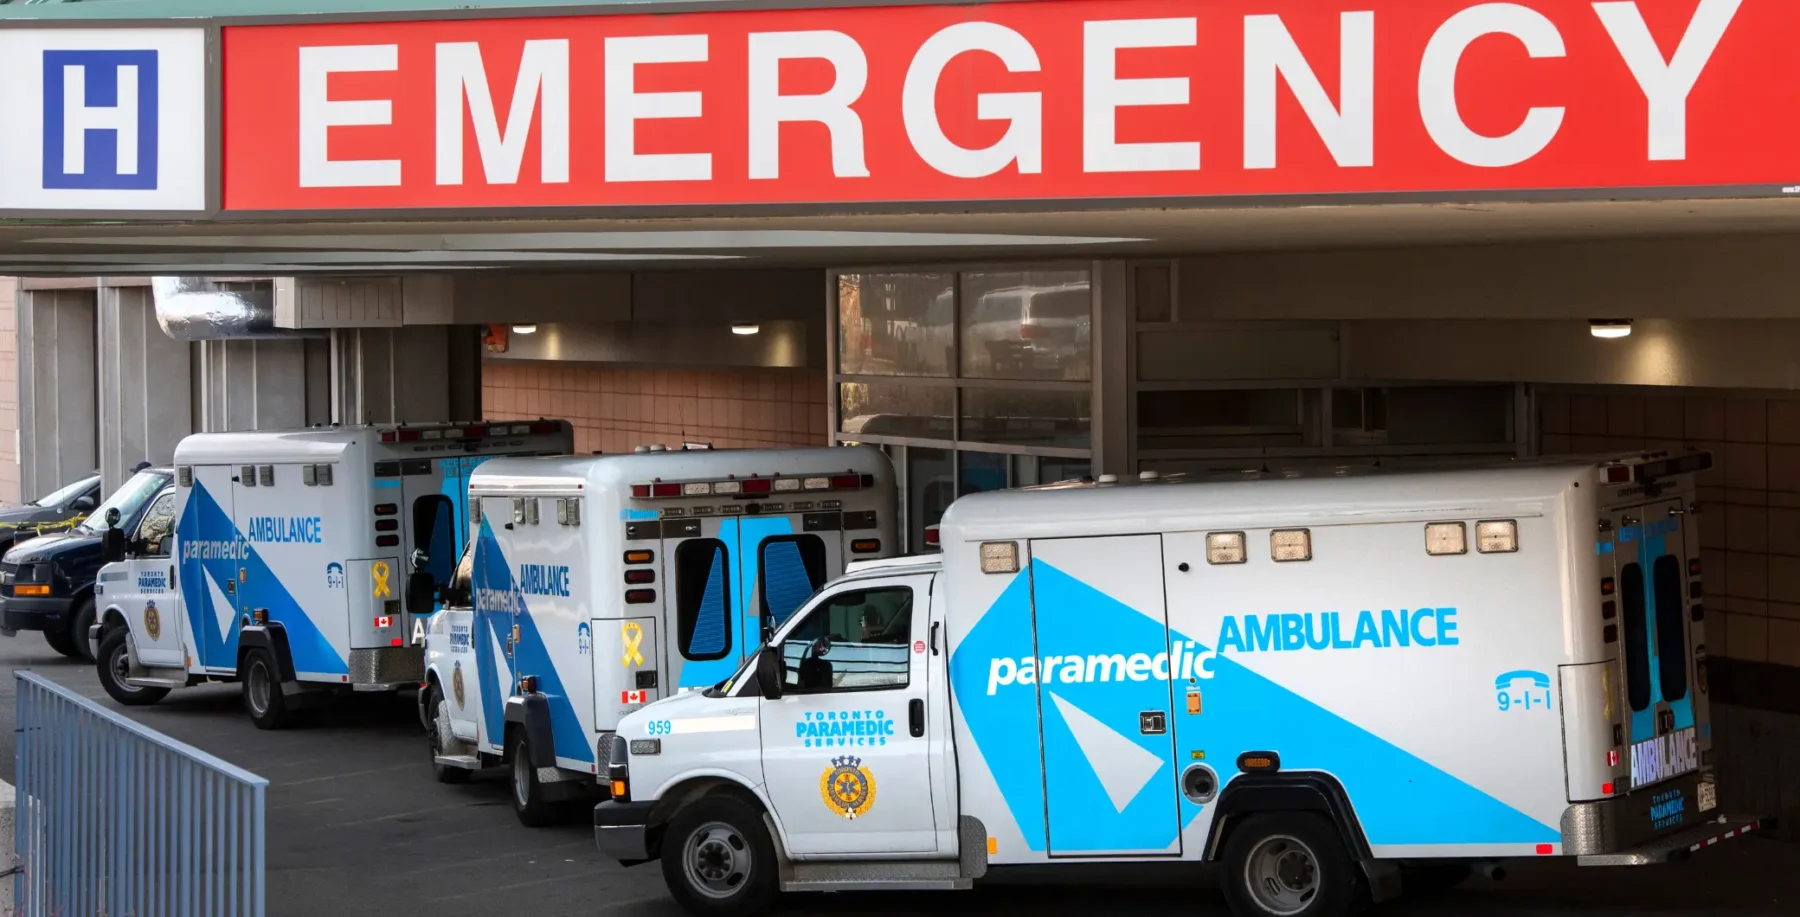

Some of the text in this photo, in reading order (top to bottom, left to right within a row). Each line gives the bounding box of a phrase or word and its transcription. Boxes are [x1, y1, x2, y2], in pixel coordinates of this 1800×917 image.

[299, 0, 1743, 188] EMERGENCY
[63, 65, 138, 175] H
[248, 516, 322, 543] AMBULANCE
[182, 534, 250, 564] paramedic
[138, 577, 166, 588] PARAMEDIC
[520, 564, 570, 597] AMBULANCE
[476, 579, 521, 617] paramedic
[1216, 607, 1459, 652] AMBULANCE
[986, 639, 1218, 696] paramedic
[1496, 690, 1551, 711] 9-1-1
[648, 720, 671, 735] 959
[796, 720, 894, 737] PARAMEDIC
[805, 710, 884, 721] TORONTO
[804, 737, 886, 748] SERVICES
[1631, 726, 1697, 788] AMBULANCE
[1650, 797, 1685, 821] PARAMEDIC
